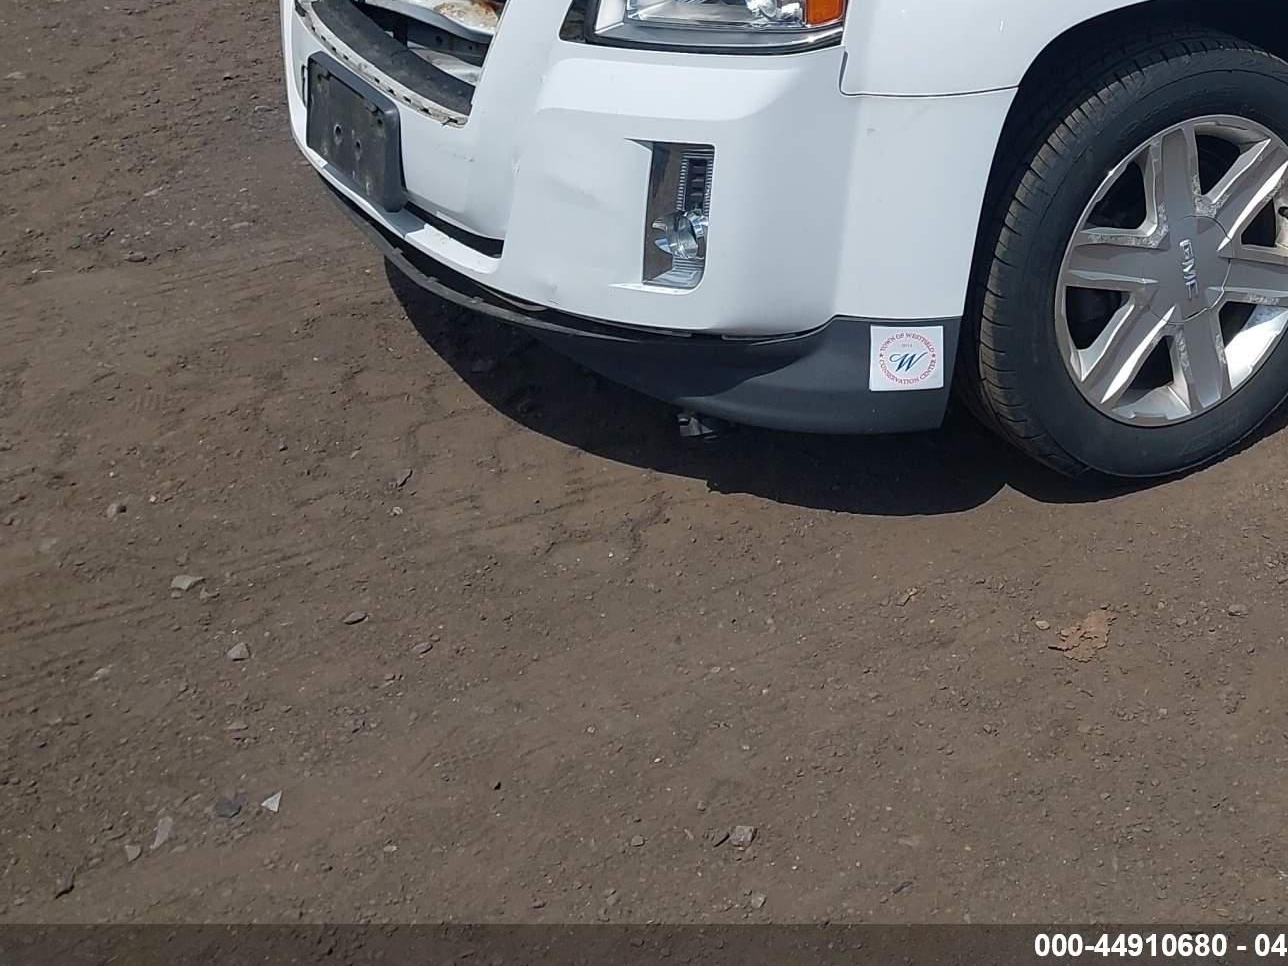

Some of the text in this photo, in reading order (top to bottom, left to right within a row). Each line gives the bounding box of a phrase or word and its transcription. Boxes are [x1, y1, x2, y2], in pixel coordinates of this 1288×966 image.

[879, 332, 935, 353] TOWN OF WESTFIELD
[879, 358, 937, 385] CONSERVATION CENTER
[889, 351, 929, 373] W
